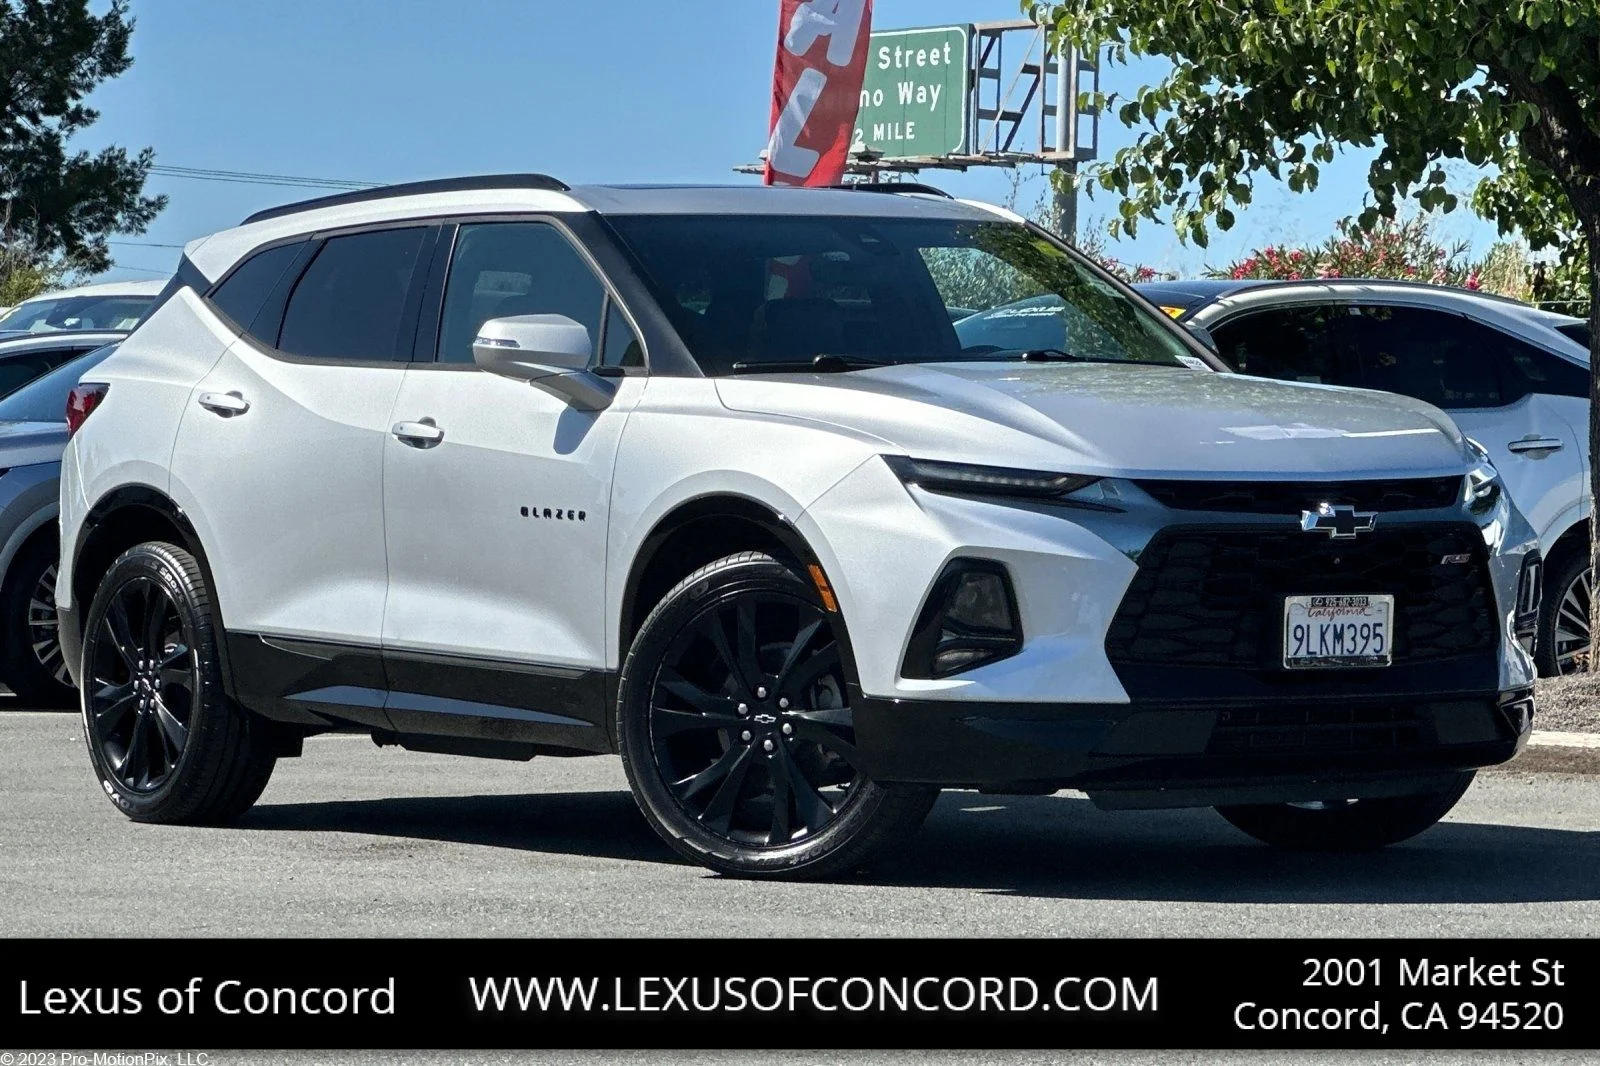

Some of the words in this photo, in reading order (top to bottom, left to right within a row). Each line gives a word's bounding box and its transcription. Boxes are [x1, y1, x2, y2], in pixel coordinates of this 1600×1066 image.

[878, 41, 951, 70] Street
[859, 88, 883, 107] no
[897, 80, 941, 112] Way
[873, 121, 915, 142] MILE
[520, 506, 586, 521] BLAZER
[1293, 622, 1384, 656] 9LKM395
